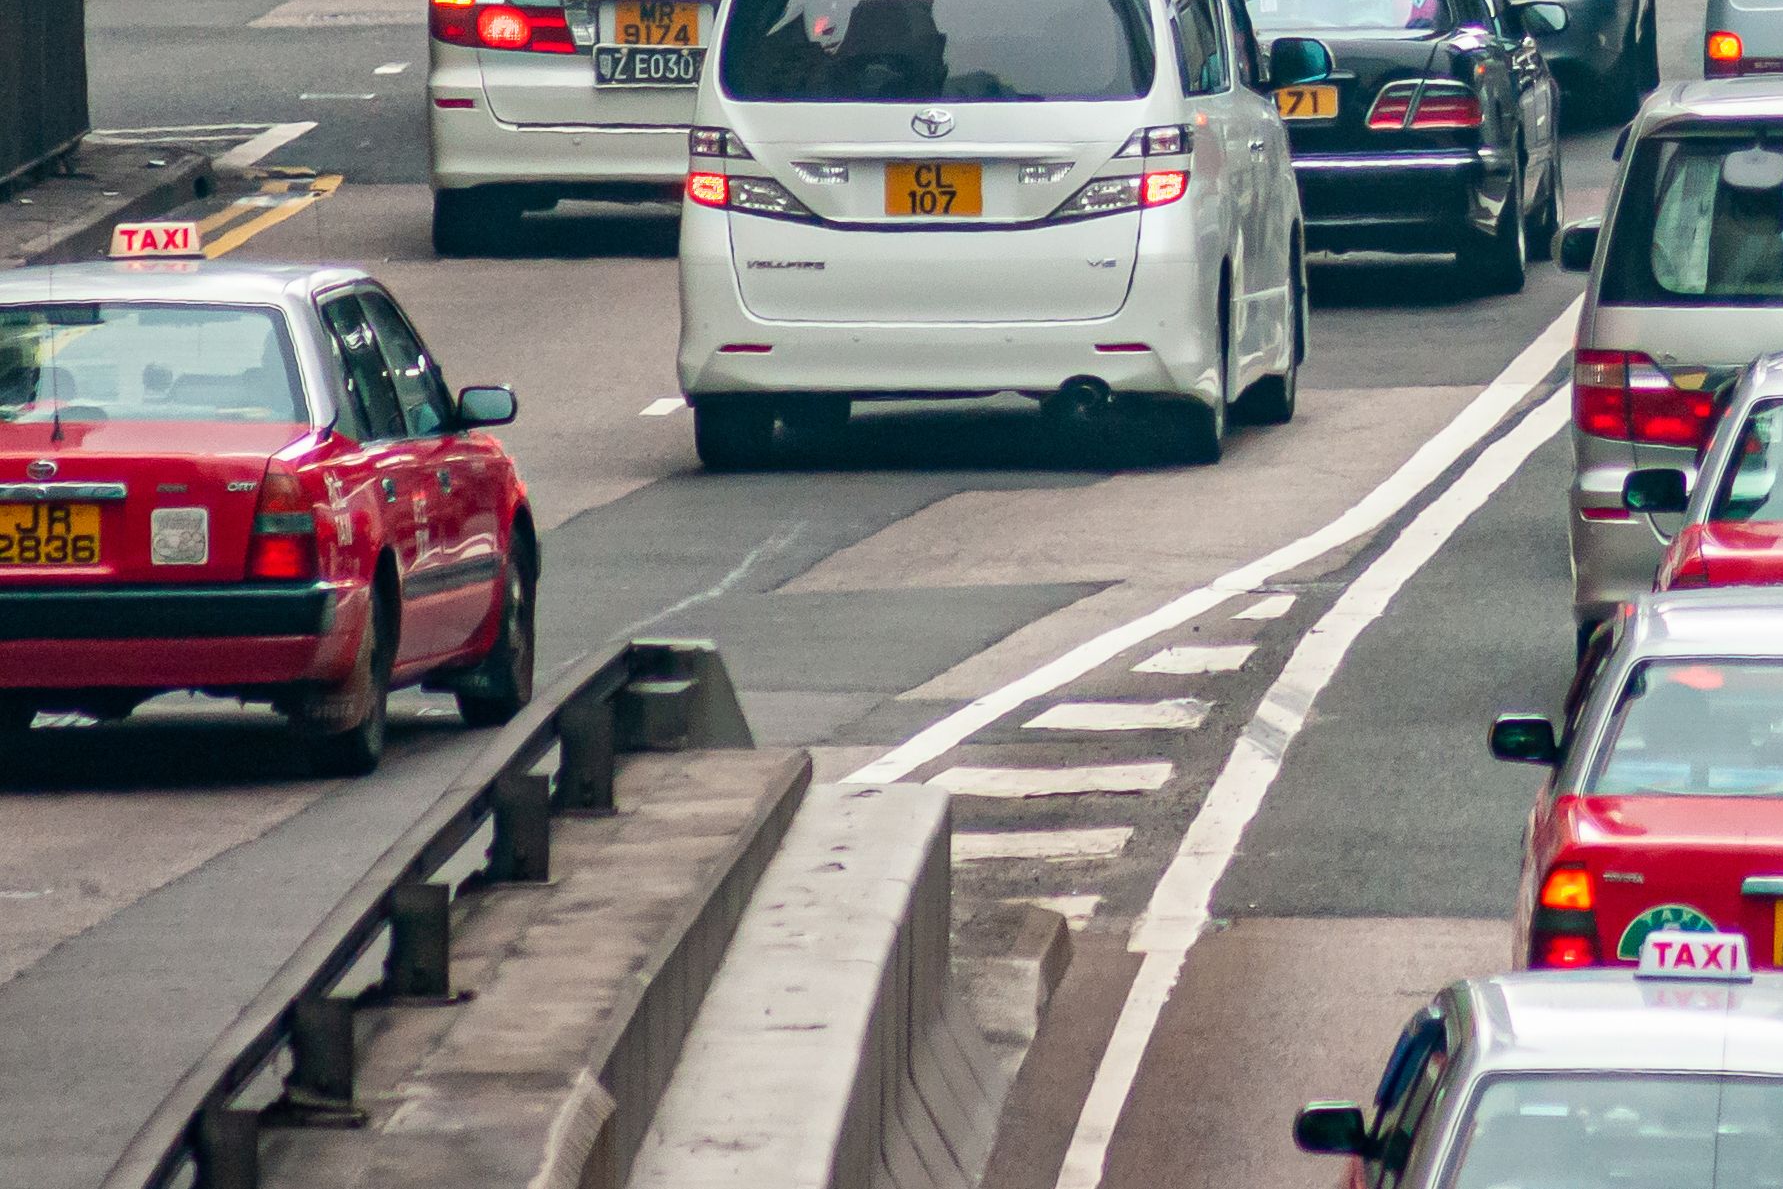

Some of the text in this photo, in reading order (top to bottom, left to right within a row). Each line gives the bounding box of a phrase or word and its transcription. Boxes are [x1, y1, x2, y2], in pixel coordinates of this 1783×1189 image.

[624, 23, 690, 47] 9174
[636, 54, 696, 80] E030
[1275, 91, 1319, 116] 71
[914, 165, 954, 189] CL
[908, 190, 957, 215] 107
[120, 227, 189, 252] TAXI
[15, 503, 71, 535] JR
[1652, 941, 1738, 971] TAXI
